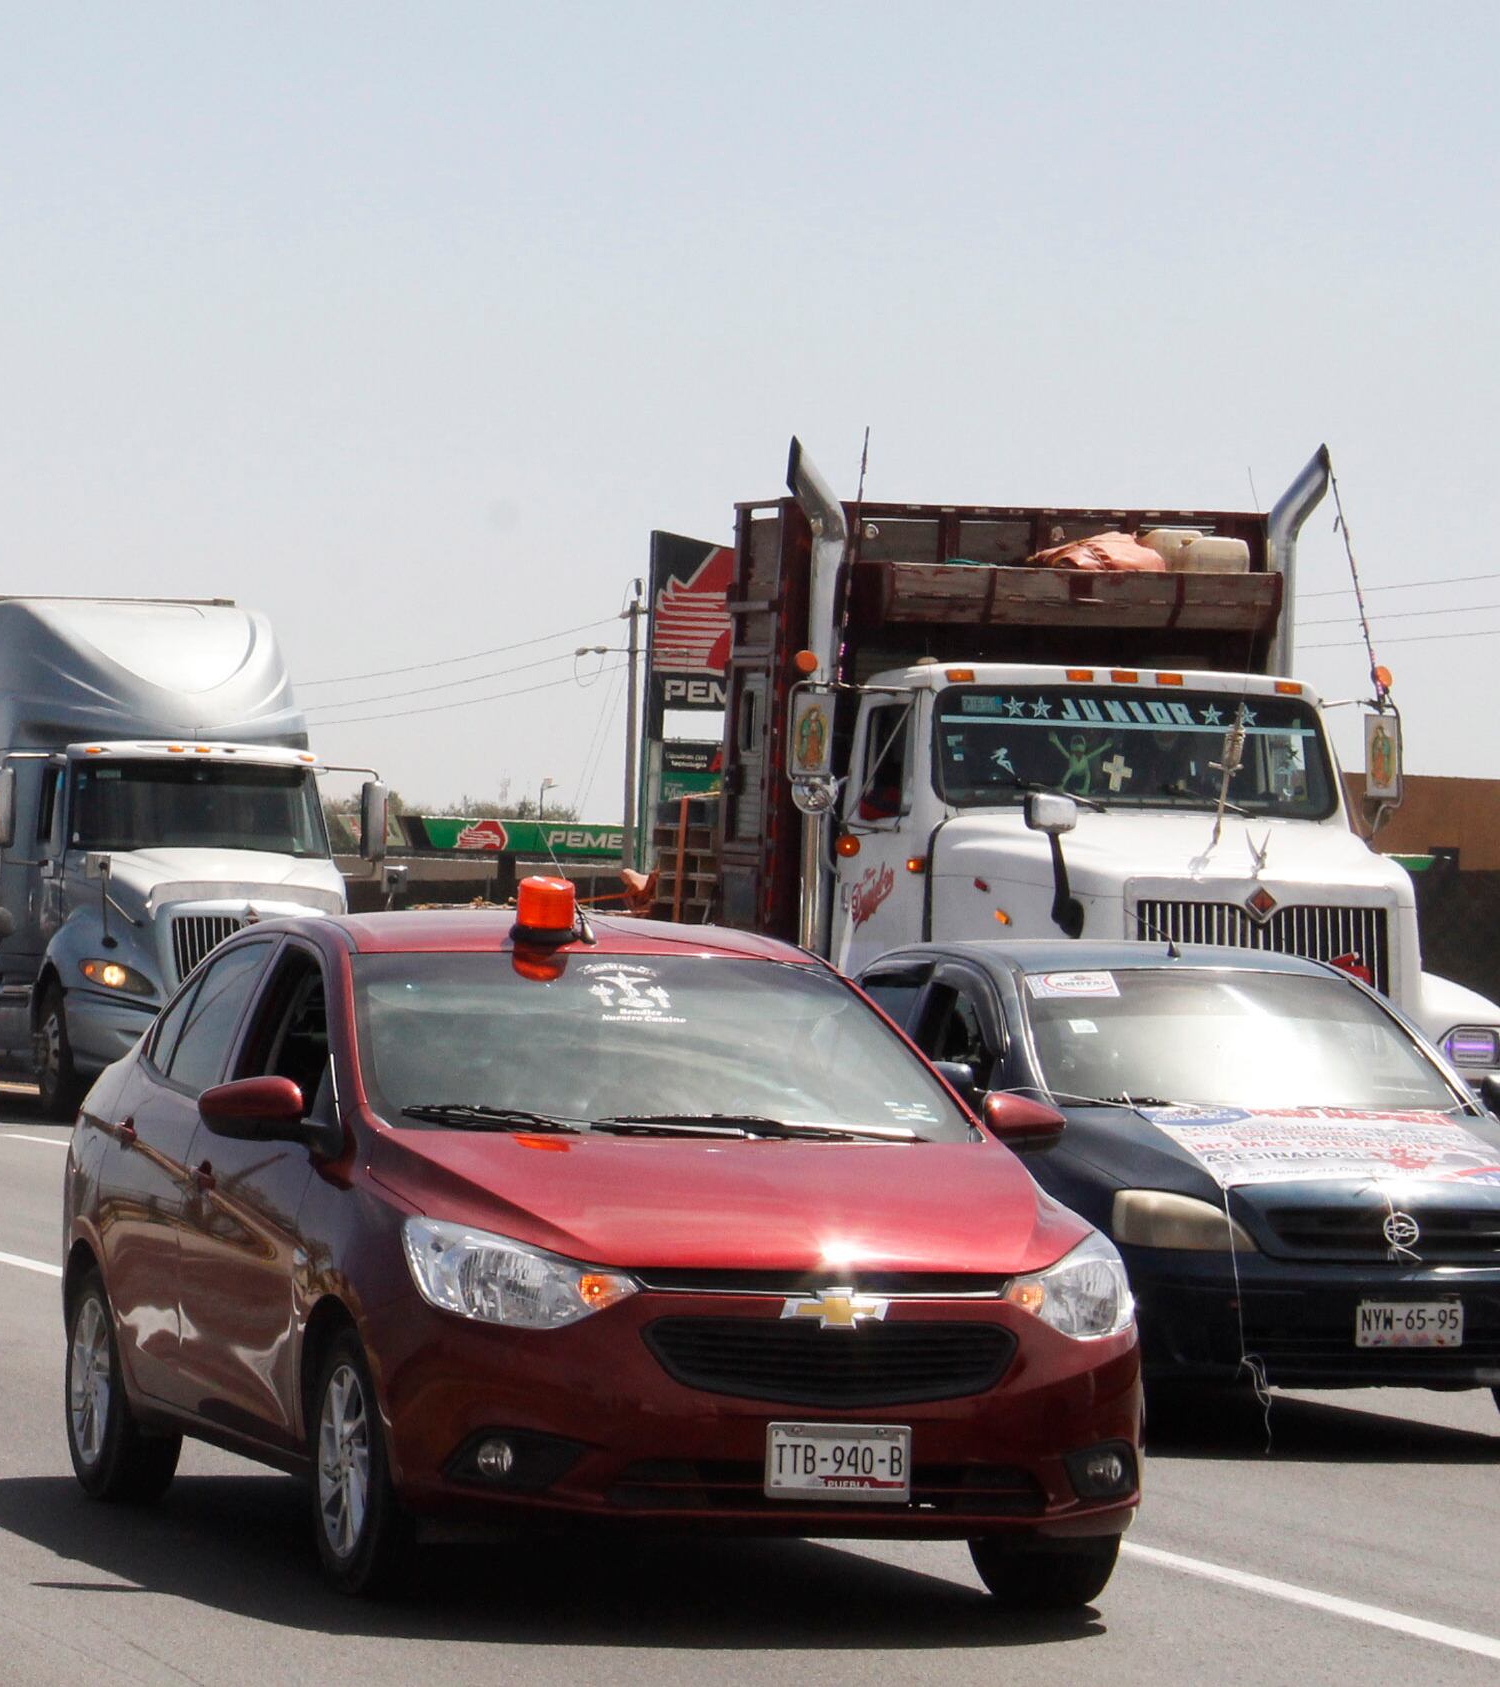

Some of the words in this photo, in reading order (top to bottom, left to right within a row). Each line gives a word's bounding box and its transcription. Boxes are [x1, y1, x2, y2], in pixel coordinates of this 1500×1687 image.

[664, 680, 727, 704] PEM
[1060, 697, 1196, 725] JUNIOR
[549, 830, 637, 849] PEME
[1240, 1140, 1292, 1148] MAS
[1361, 1308, 1460, 1331] NYW-65-95
[775, 1443, 903, 1477] TTB-940-B
